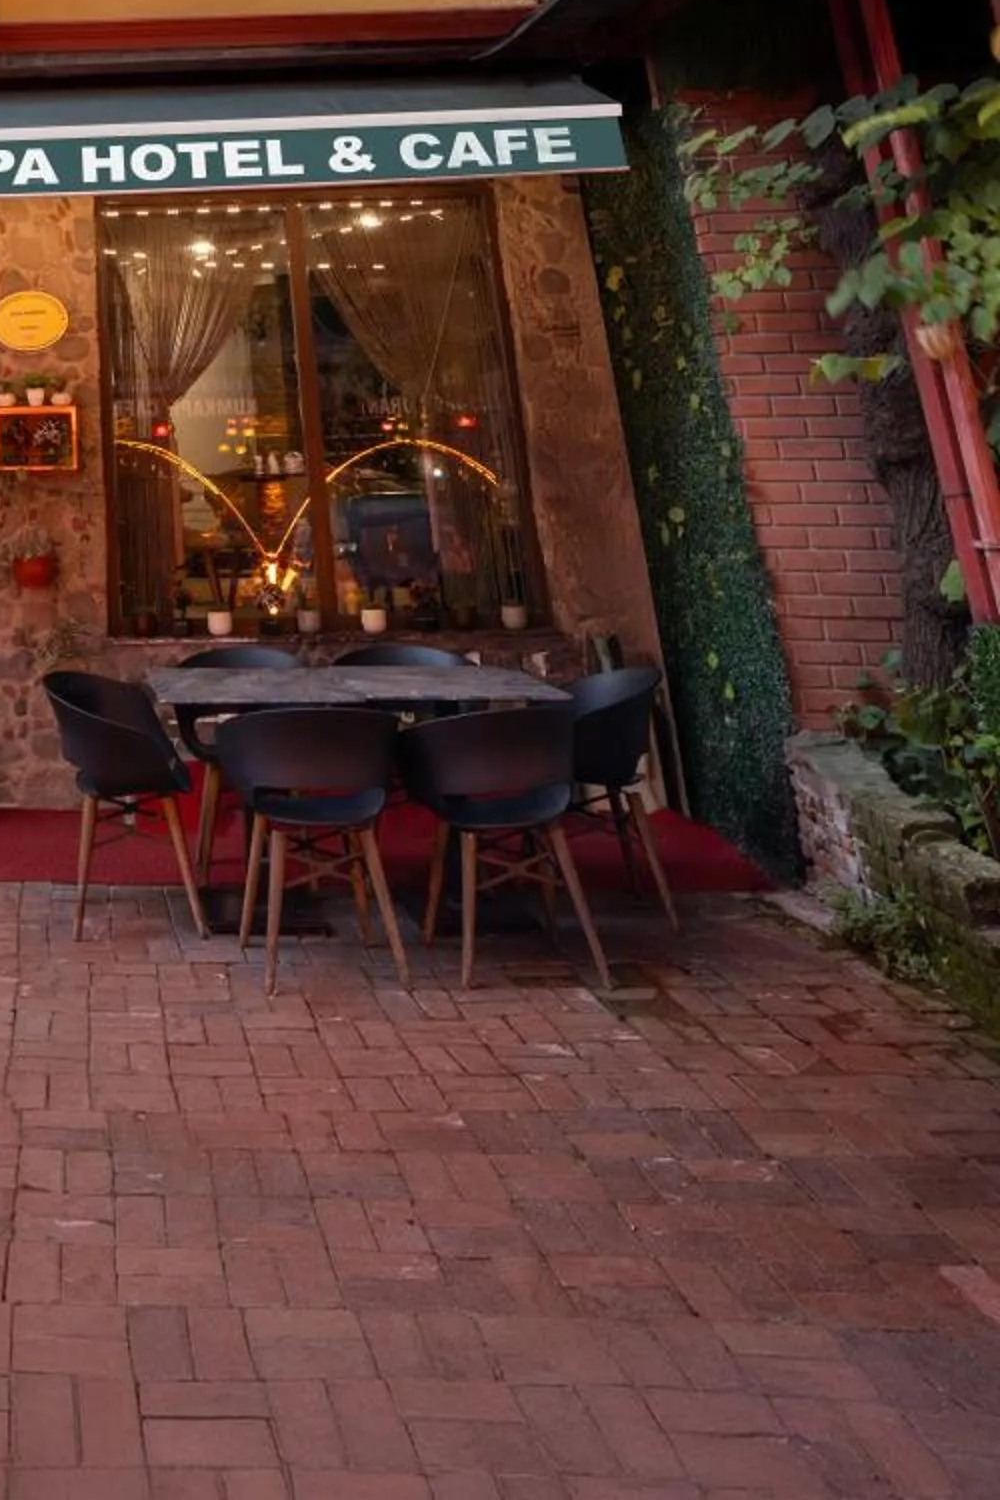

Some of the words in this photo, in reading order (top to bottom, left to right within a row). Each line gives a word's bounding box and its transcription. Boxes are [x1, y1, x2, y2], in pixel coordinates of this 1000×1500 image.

[82, 140, 304, 182] HOTEL
[329, 136, 376, 172] &
[400, 128, 576, 169] CAFE
